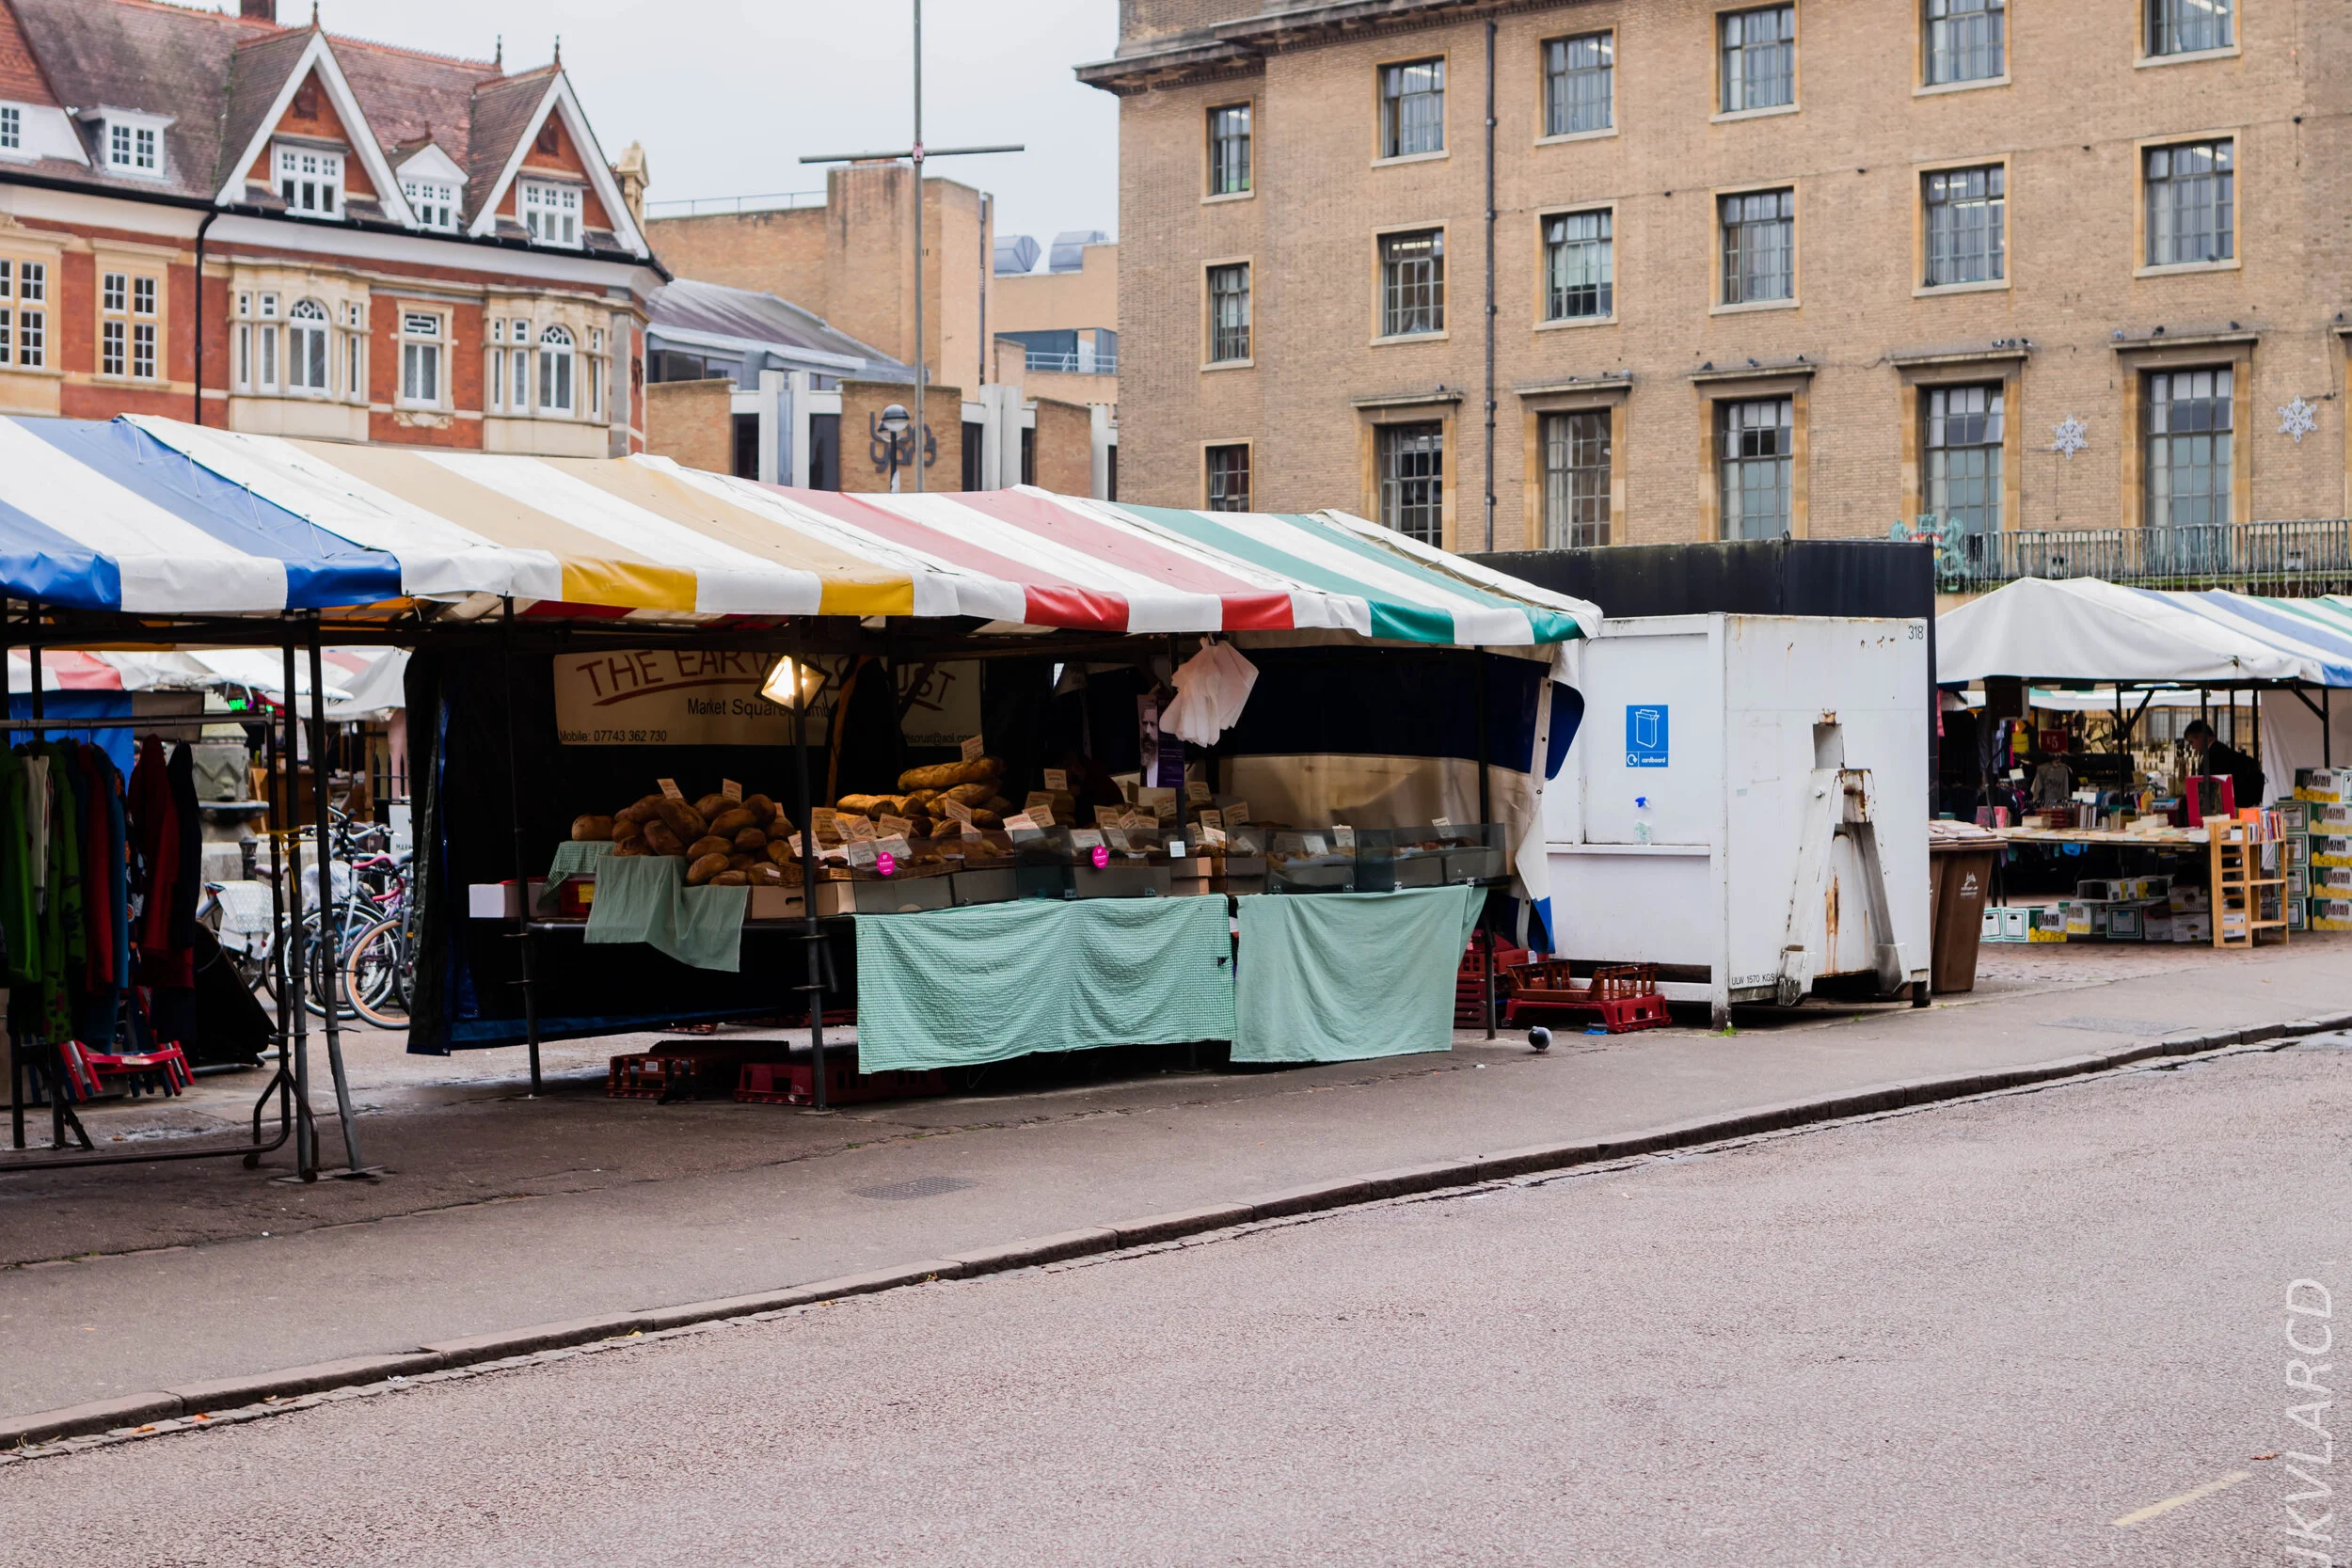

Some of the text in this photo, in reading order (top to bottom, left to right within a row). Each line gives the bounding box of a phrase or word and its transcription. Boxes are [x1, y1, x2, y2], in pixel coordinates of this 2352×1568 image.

[1908, 625, 1924, 640] 318
[576, 650, 664, 697] THE
[688, 698, 726, 716] Market
[559, 730, 667, 742] Mobile: 07743 362 730
[1732, 973, 1774, 985] ULW 1570 KGS
